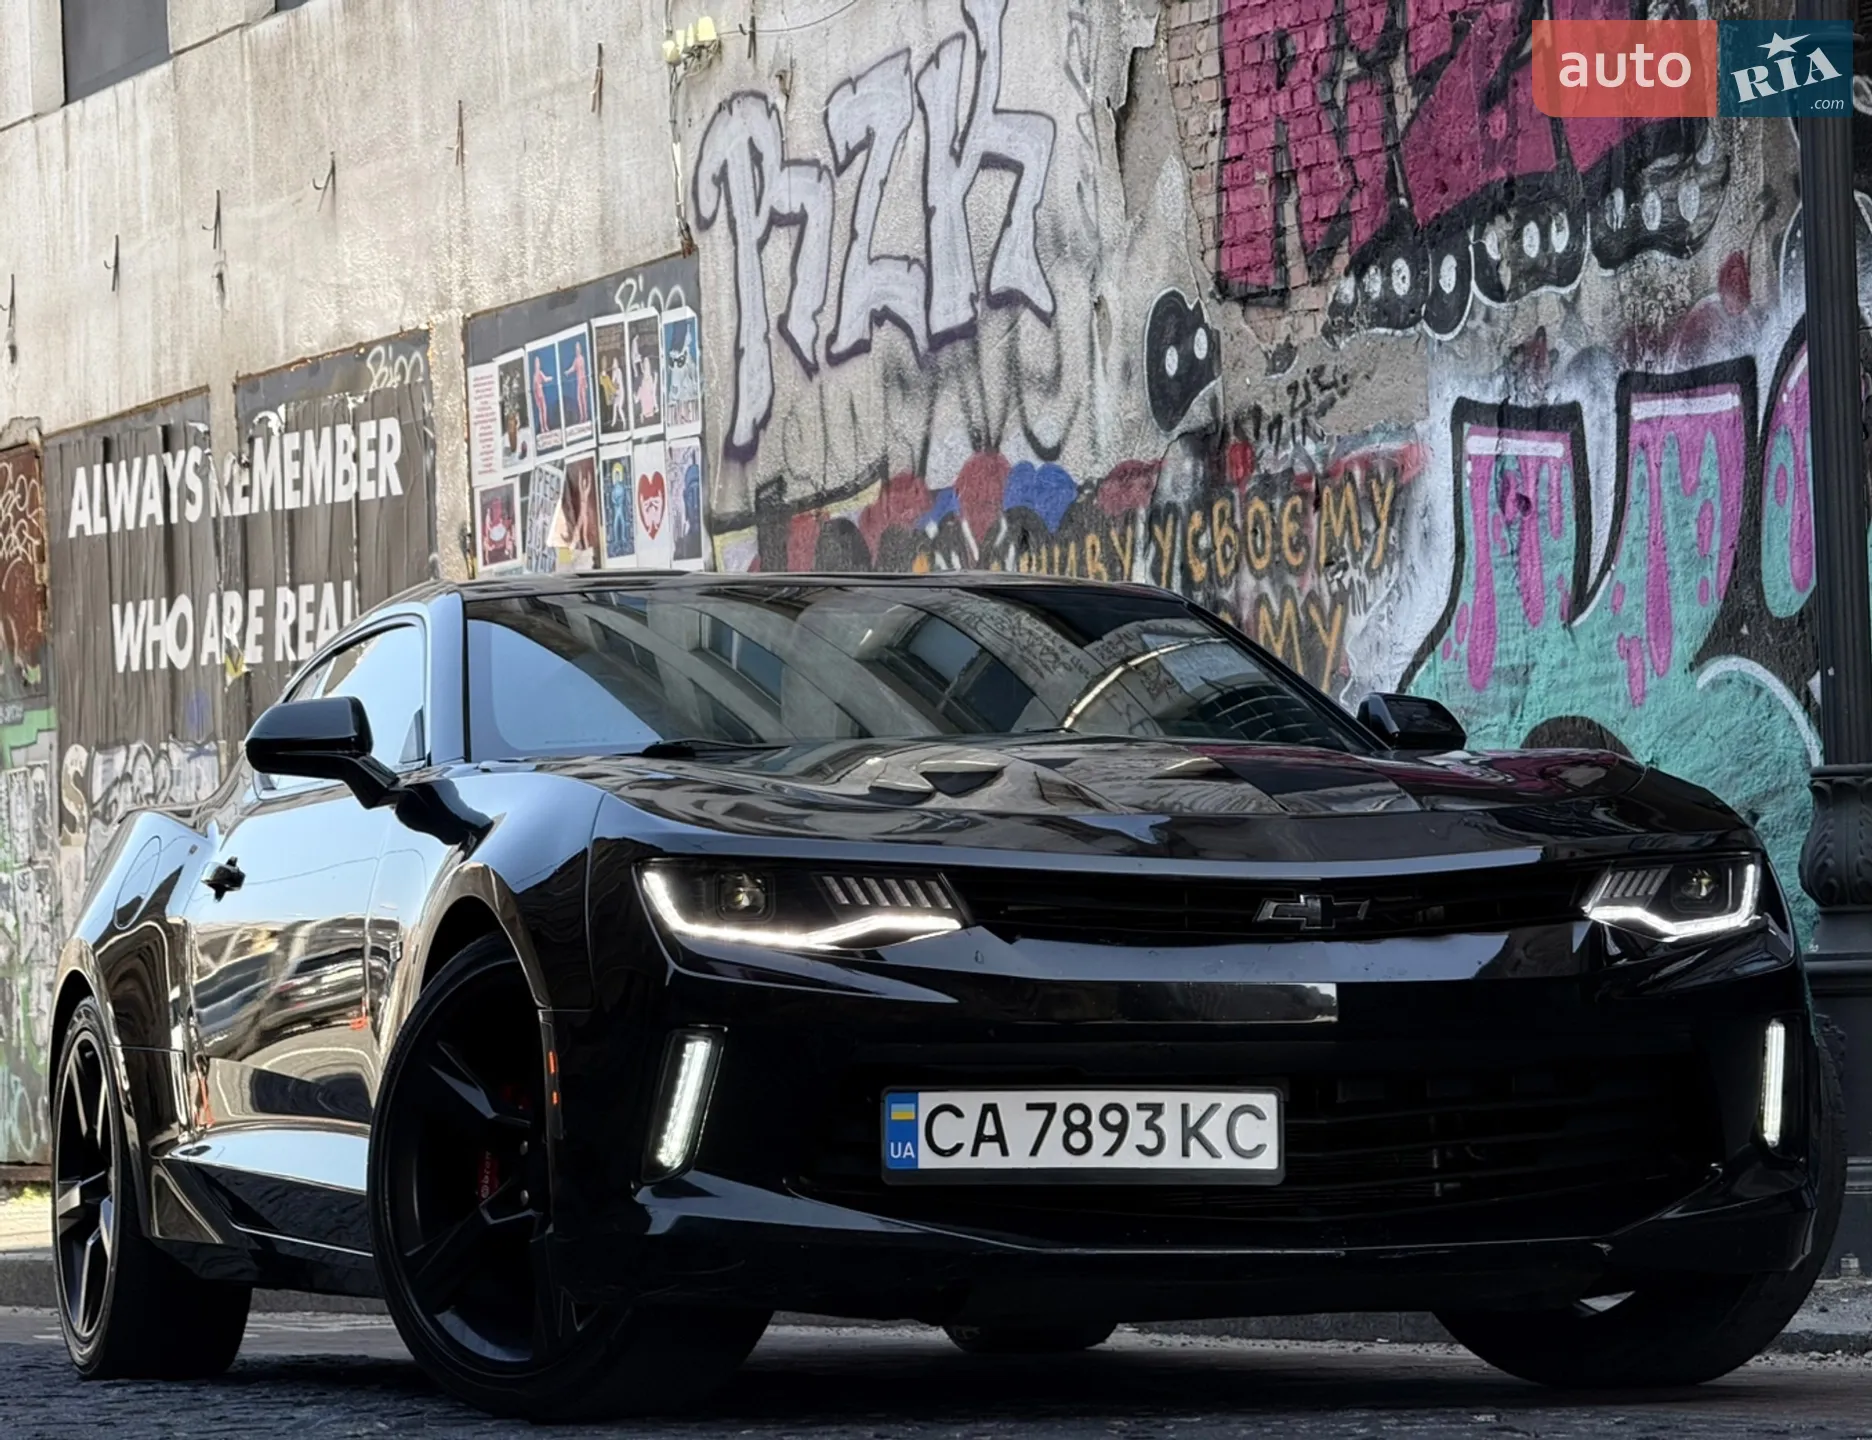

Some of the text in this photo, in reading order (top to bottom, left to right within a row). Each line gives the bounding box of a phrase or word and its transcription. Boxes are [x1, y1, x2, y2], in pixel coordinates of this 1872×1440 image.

[68, 446, 203, 538] ALWAYS
[209, 417, 403, 518] REMEMBER
[112, 593, 194, 673] WHO
[201, 588, 265, 666] ARE
[889, 1141, 915, 1159] UA
[1025, 1102, 1166, 1157] 7893
